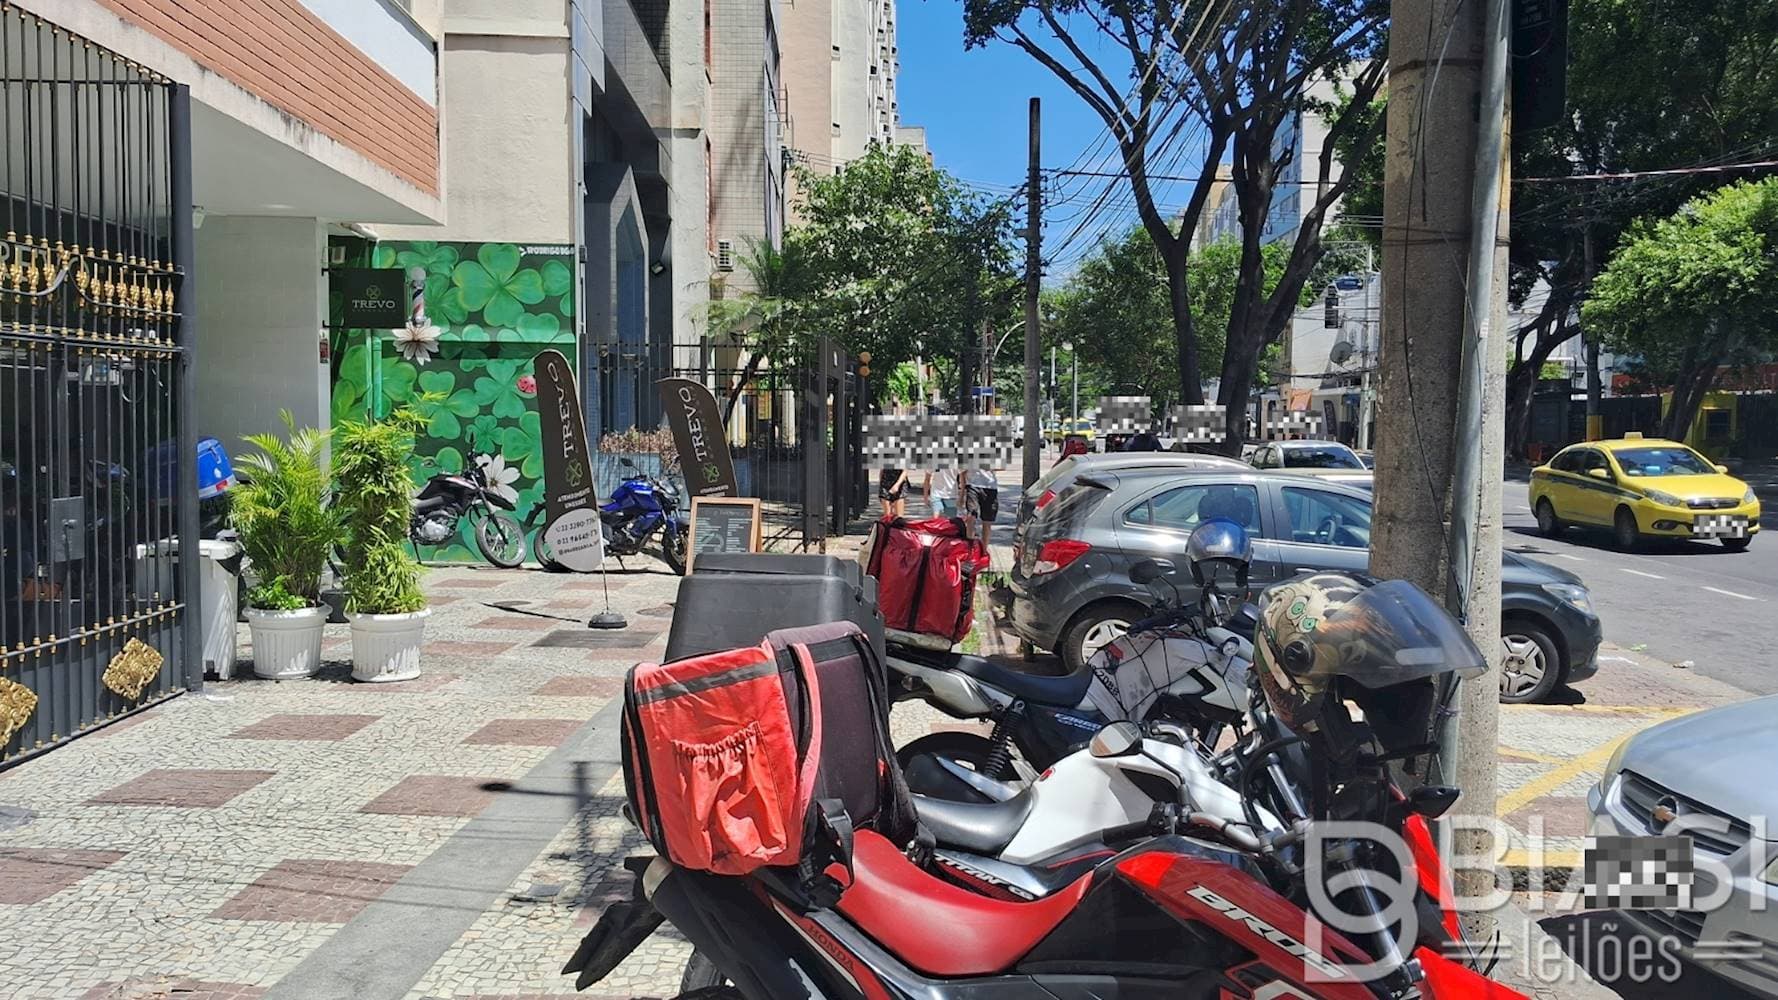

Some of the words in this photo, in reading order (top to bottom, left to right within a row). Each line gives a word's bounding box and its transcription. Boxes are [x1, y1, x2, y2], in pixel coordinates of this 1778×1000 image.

[352, 300, 396, 309] TREVO
[547, 362, 574, 458] TREVO
[679, 387, 707, 462] TREVO
[806, 924, 855, 974] HONDA
[1186, 884, 1349, 979] BROS
